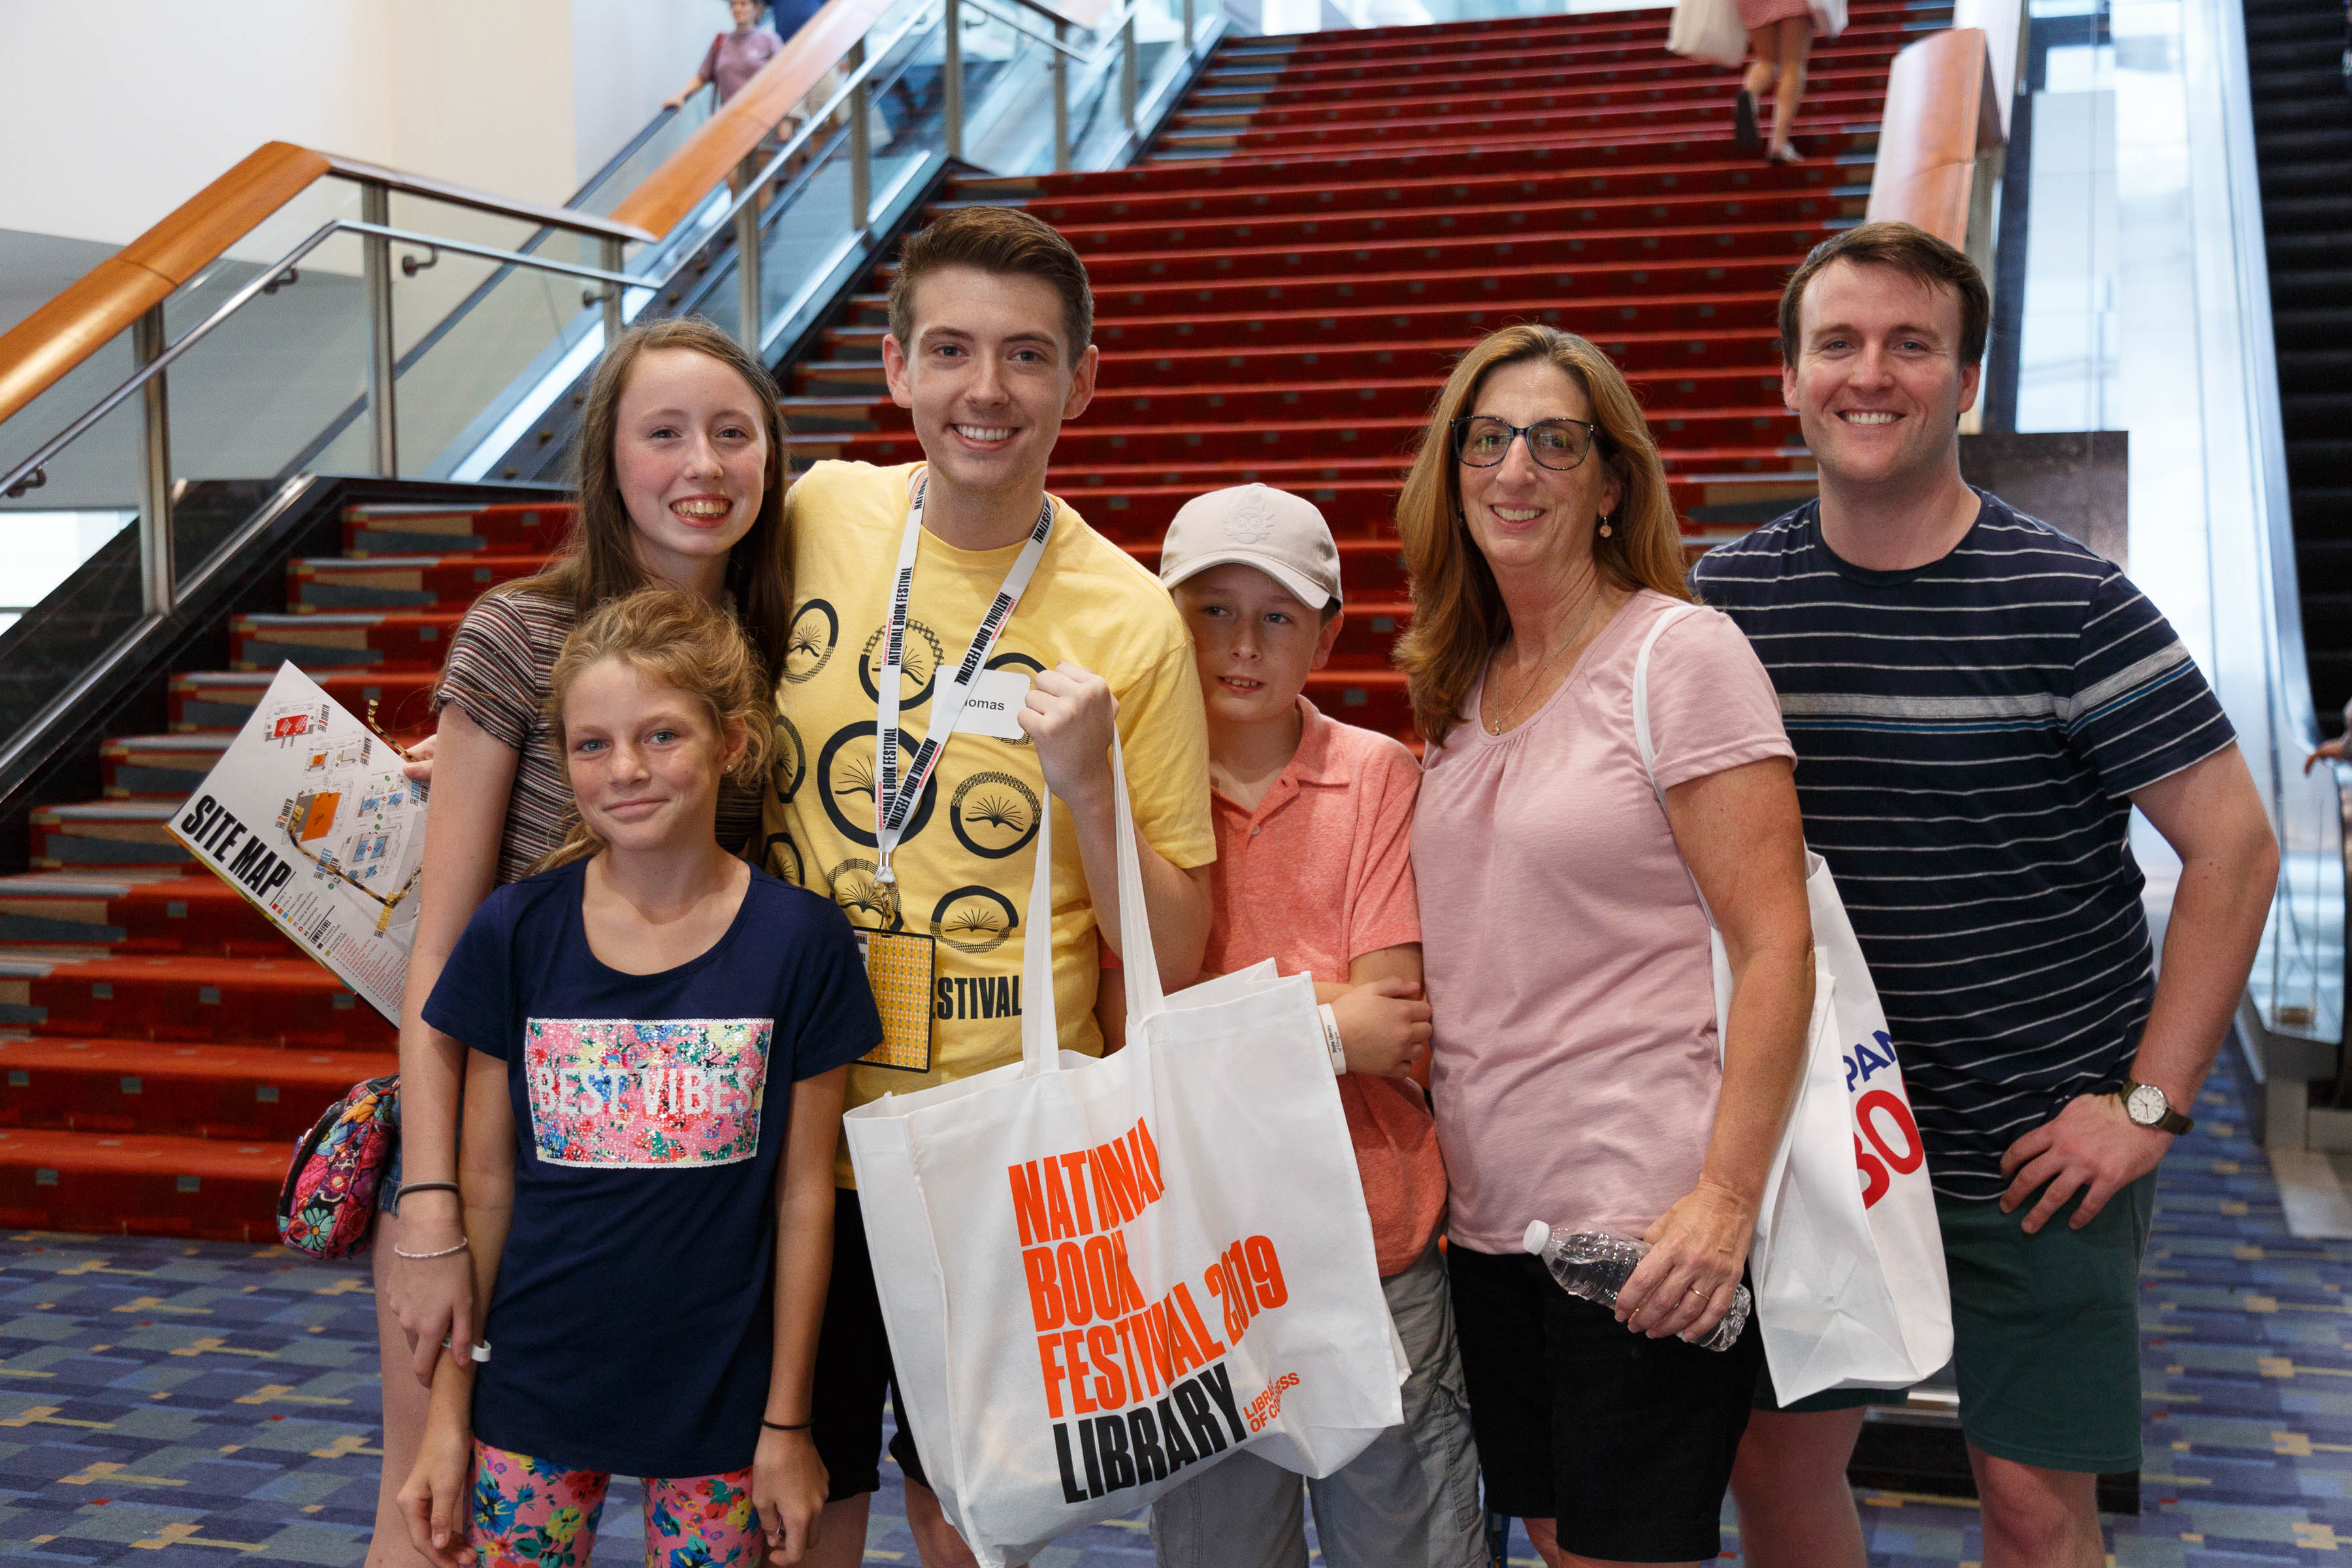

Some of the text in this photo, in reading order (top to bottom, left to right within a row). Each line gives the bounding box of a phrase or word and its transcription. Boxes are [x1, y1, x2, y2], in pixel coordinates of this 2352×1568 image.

[888, 566, 912, 666] NATIONAL BOOK FESTIVAL
[954, 592, 1012, 686] NATIONAL BOOK FESTIVAL
[883, 728, 897, 765] FESTIVAL
[883, 766, 897, 790] BOOK
[282, 798, 294, 818] NORTH
[886, 738, 938, 830] NATIONAL BOOK FESTIVAL
[181, 794, 292, 898] SITE MAP
[310, 920, 331, 944] LOWER LEVEL
[932, 975, 1022, 1020] STIVAL
[537, 1067, 755, 1115] BEST VIBES
[1022, 1230, 1146, 1332] BOOK
[1037, 1235, 1288, 1419] FESTIVAL 2019
[1053, 1361, 1247, 1504] LIBRARY
[1250, 1411, 1267, 1432] OF
